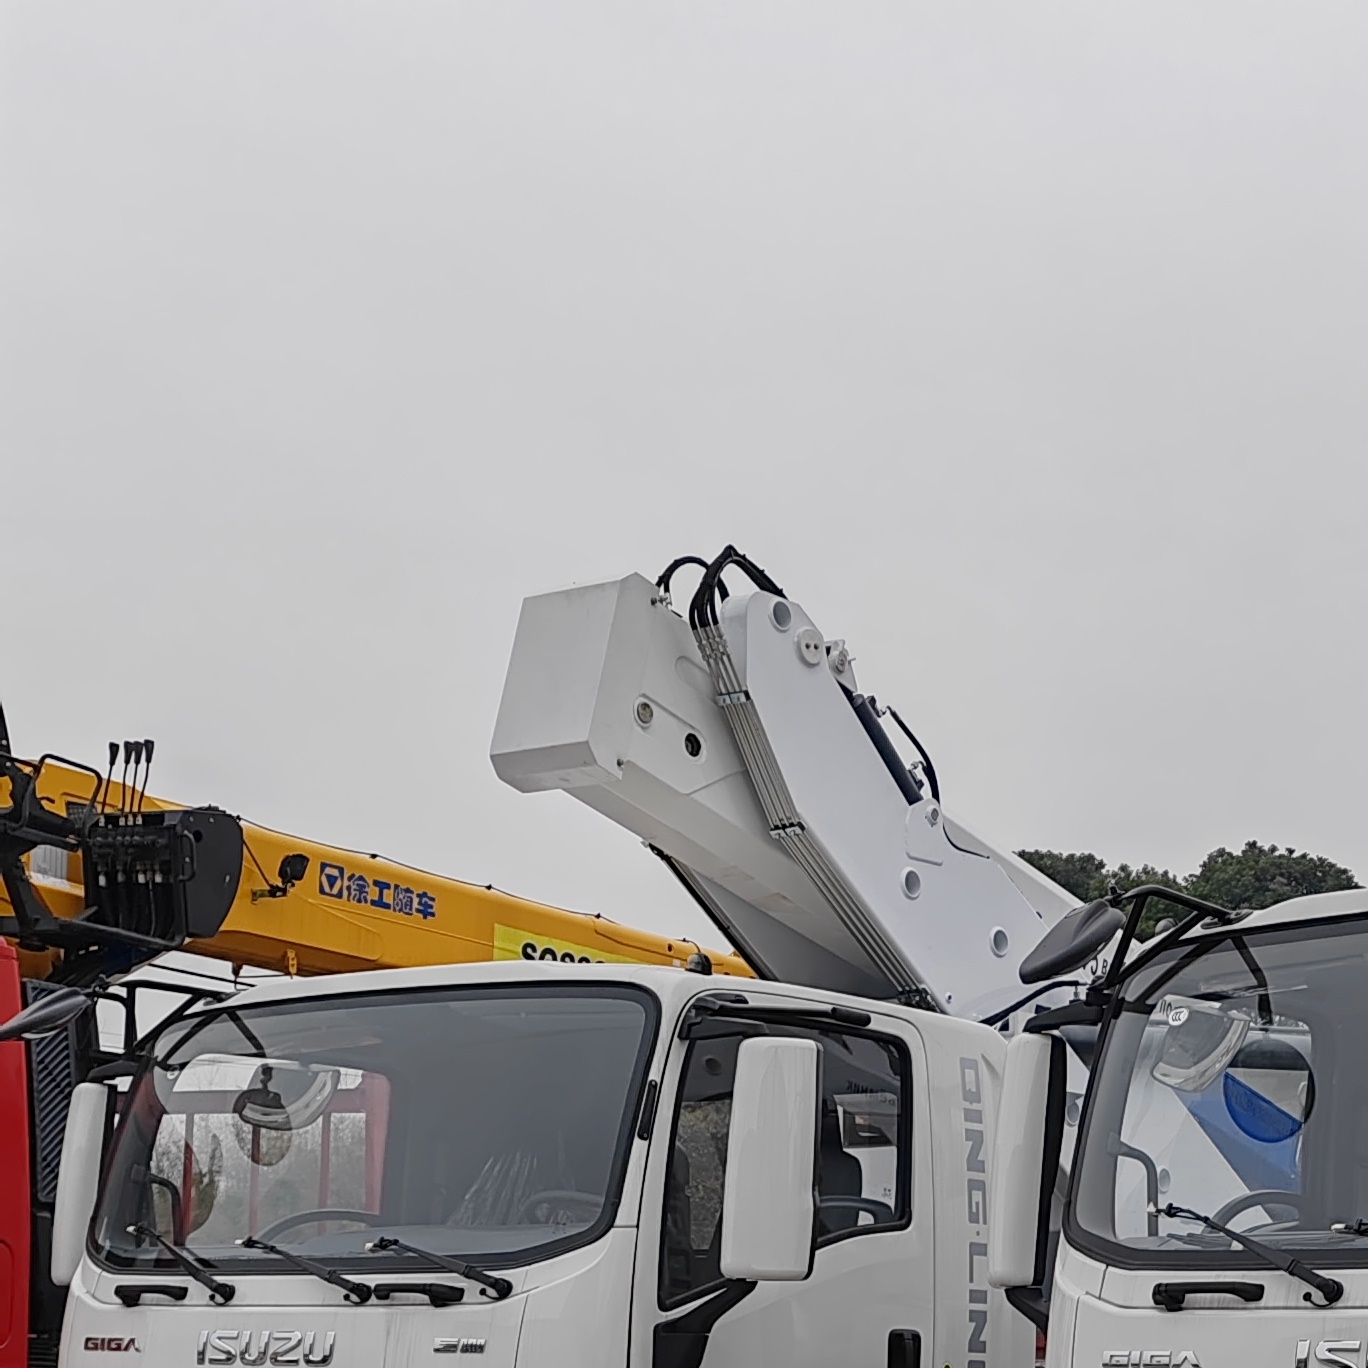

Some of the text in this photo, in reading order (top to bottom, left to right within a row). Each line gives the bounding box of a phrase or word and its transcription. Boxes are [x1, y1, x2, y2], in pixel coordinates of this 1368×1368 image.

[346, 873, 436, 919] 徐工随车
[84, 1337, 141, 1352] GIGA
[196, 1330, 335, 1367] ISUZU
[1101, 1350, 1202, 1368] GIGA
